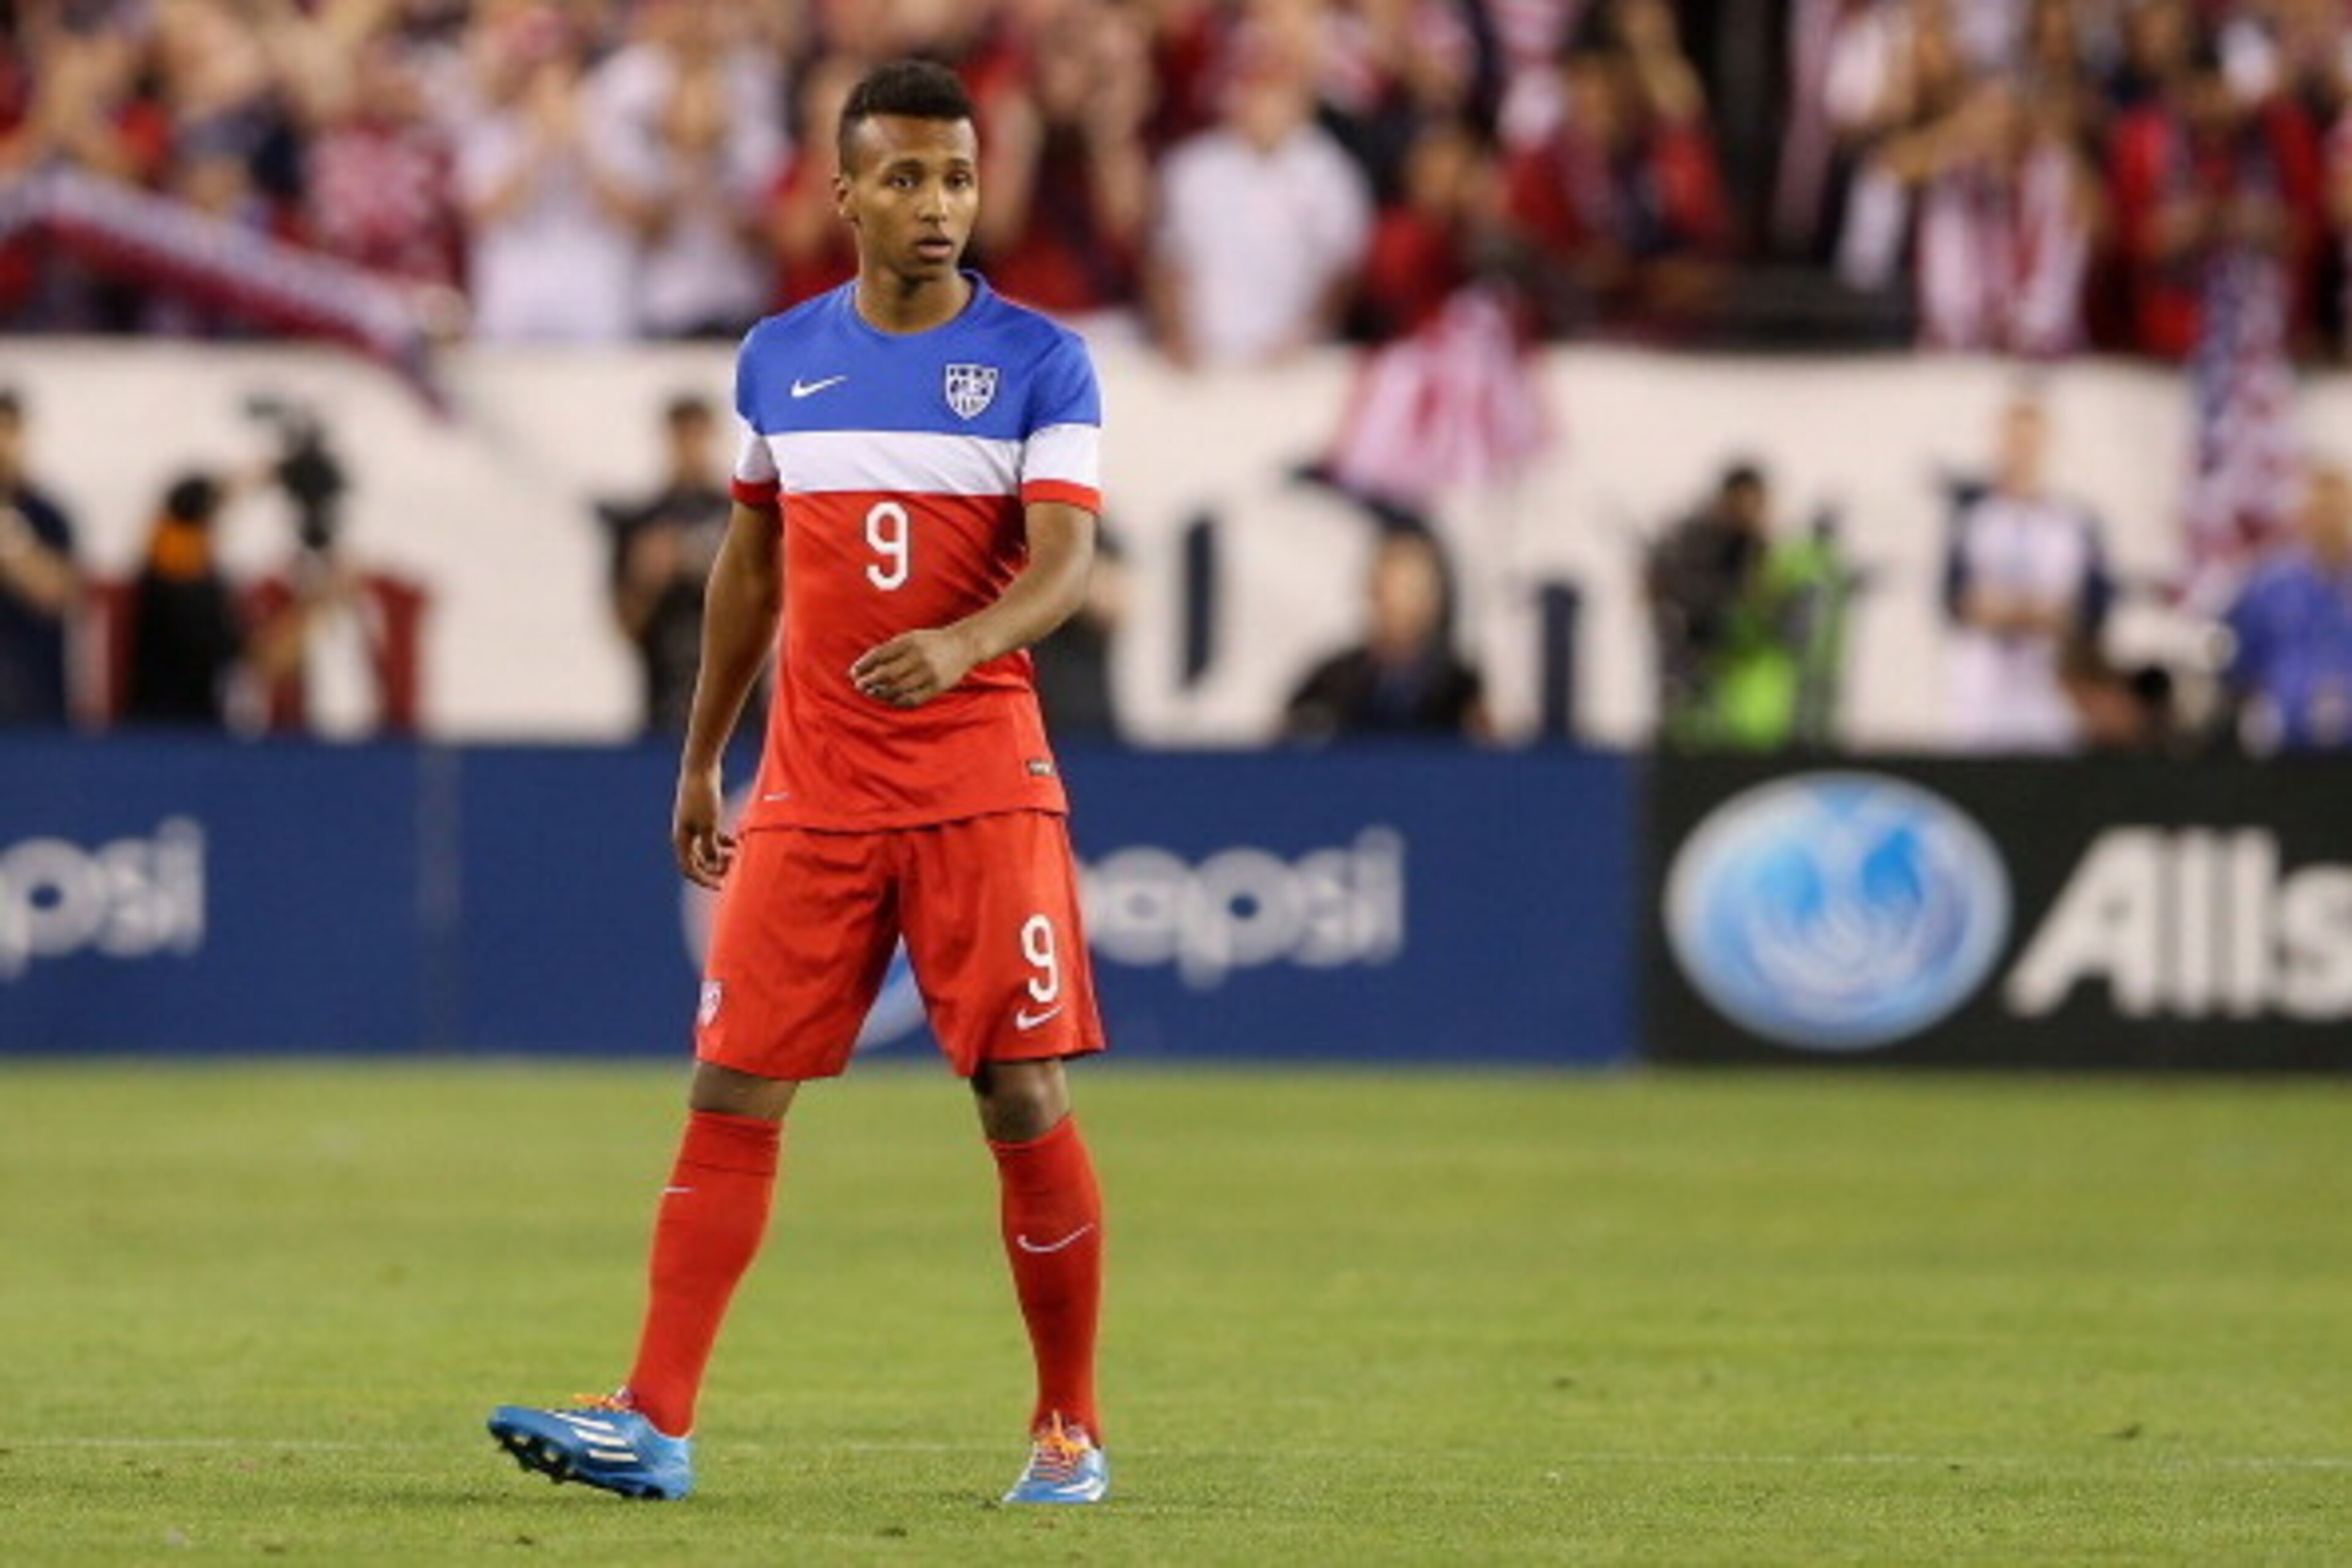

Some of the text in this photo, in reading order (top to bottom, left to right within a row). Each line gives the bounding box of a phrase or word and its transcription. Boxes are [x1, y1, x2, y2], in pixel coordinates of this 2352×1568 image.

[866, 501, 908, 590] 9
[1076, 824, 1404, 990] epsi
[1021, 913, 1058, 1003] 9
